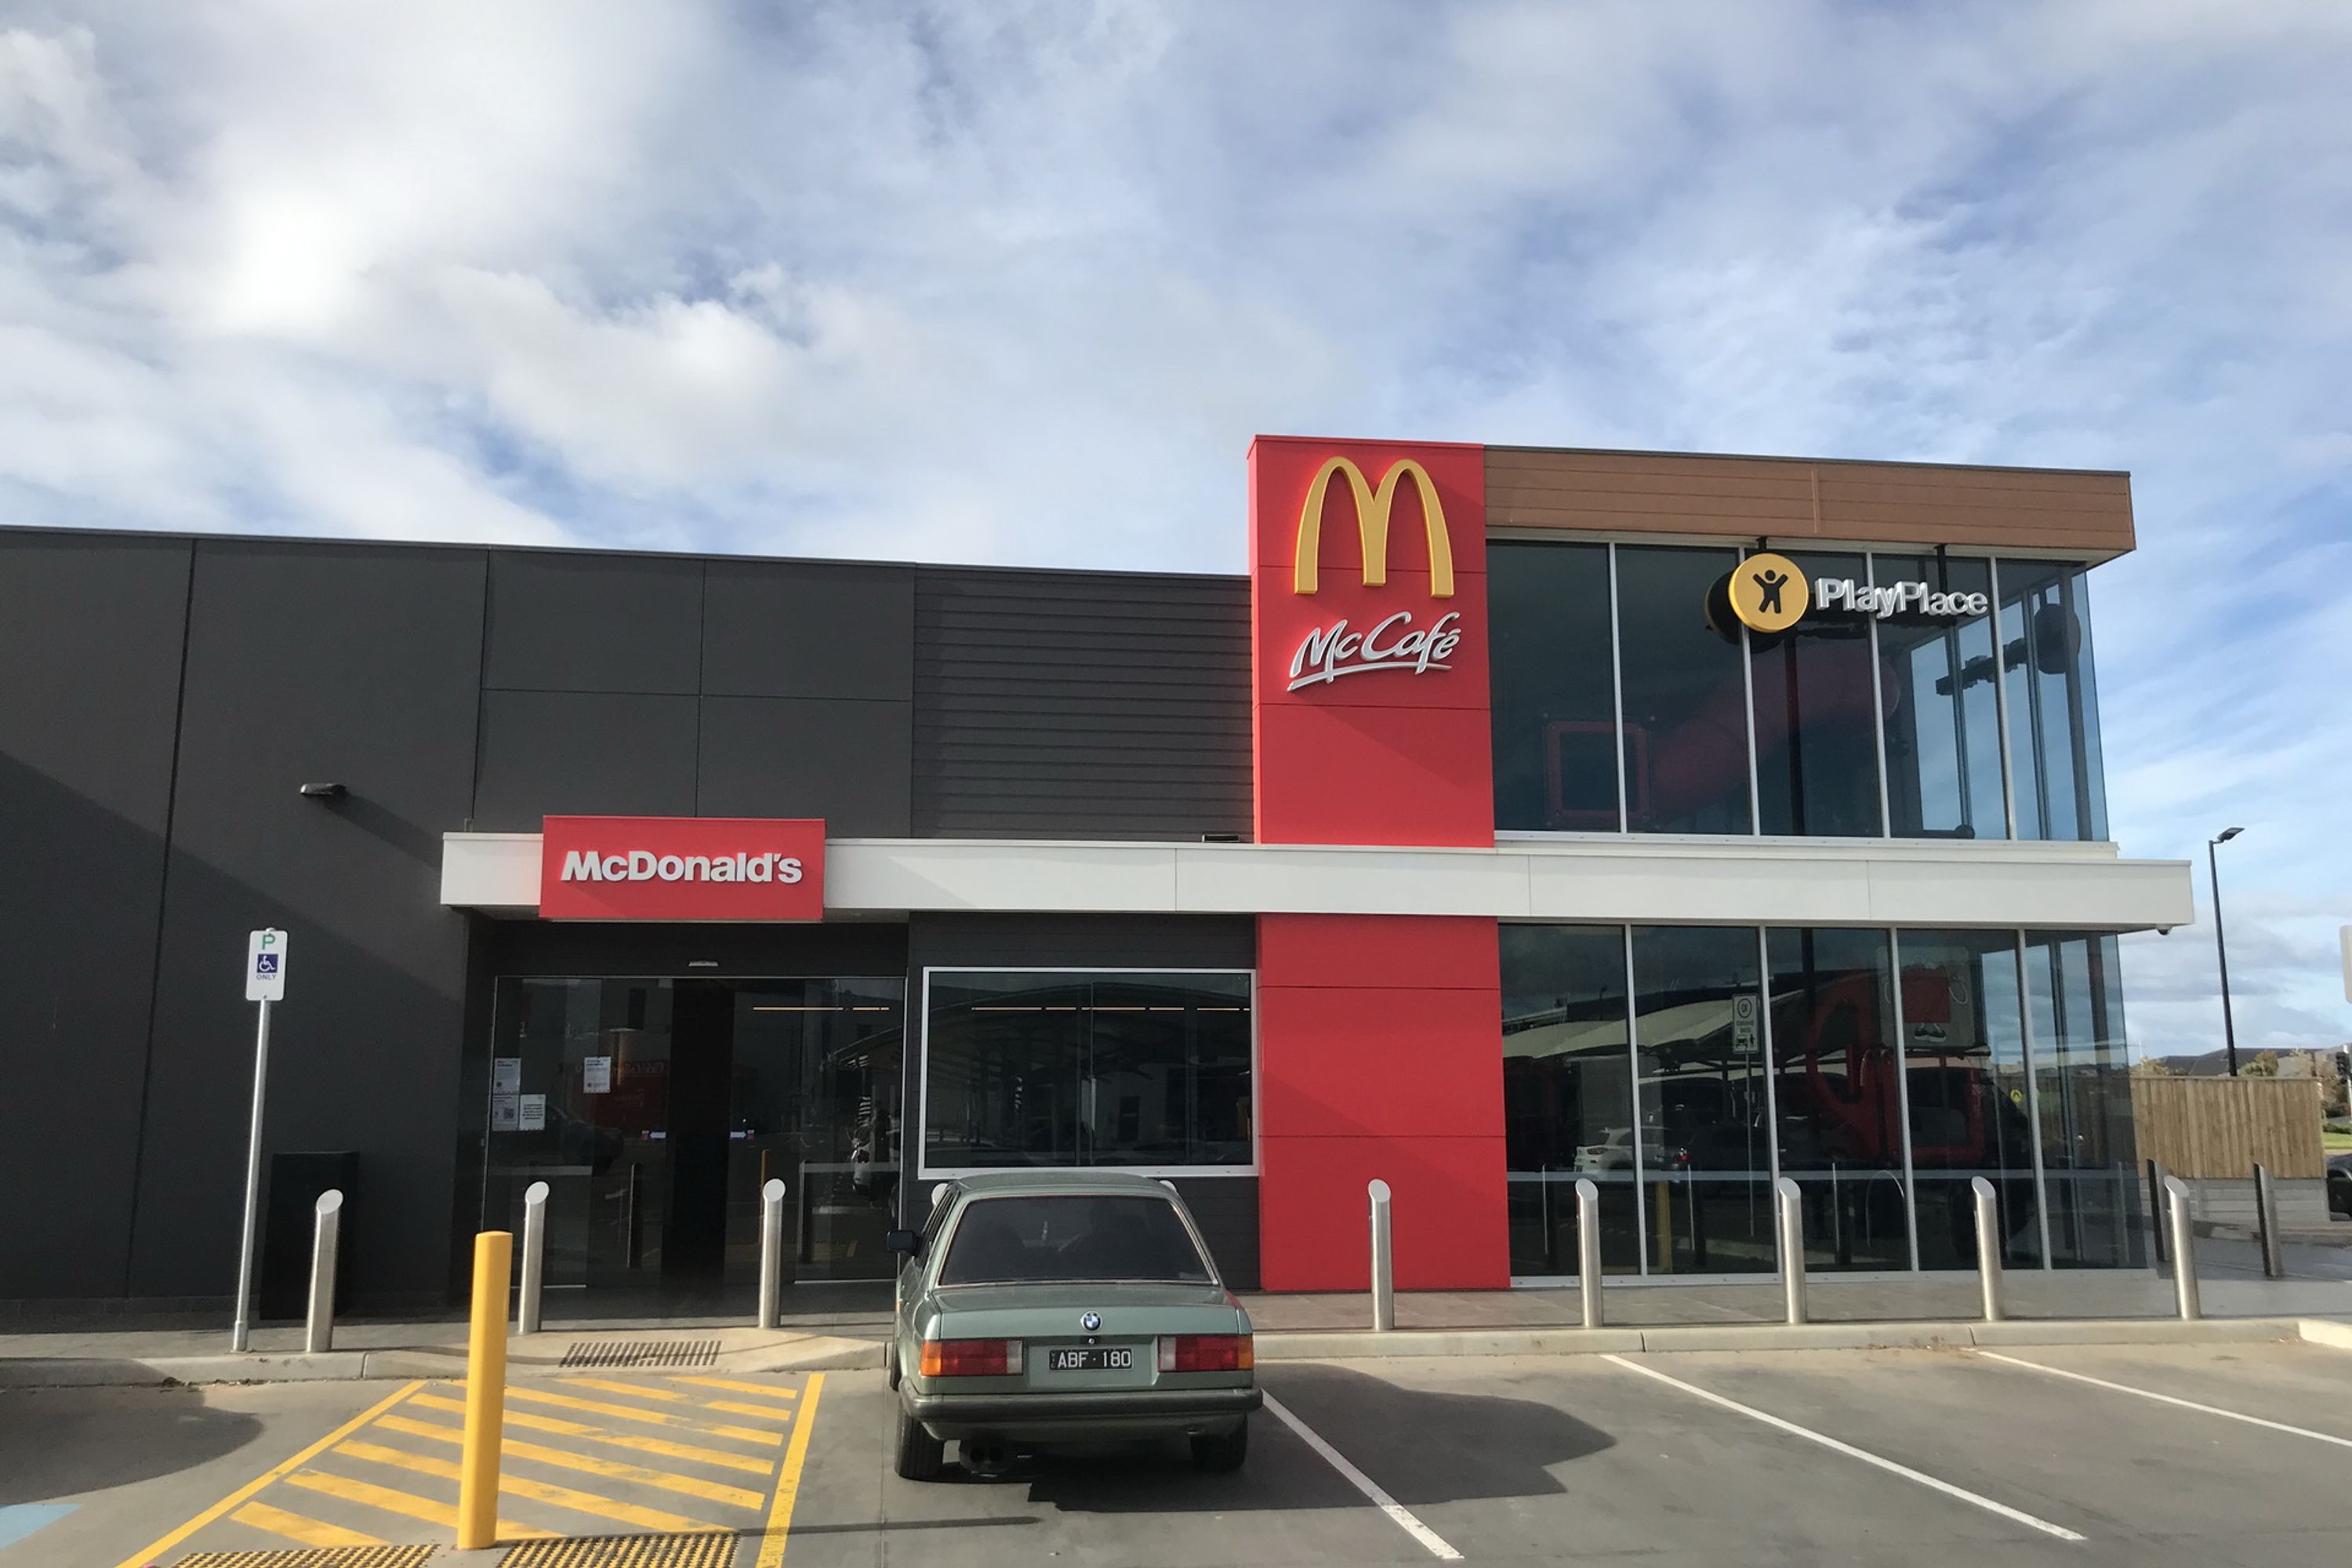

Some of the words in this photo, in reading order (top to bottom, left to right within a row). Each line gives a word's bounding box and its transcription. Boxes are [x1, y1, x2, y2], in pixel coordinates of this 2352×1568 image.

[1815, 578, 1988, 619] PlayPlace
[1290, 612, 1461, 683] McCafé
[561, 851, 803, 884] McDonald's
[262, 934, 276, 950] P
